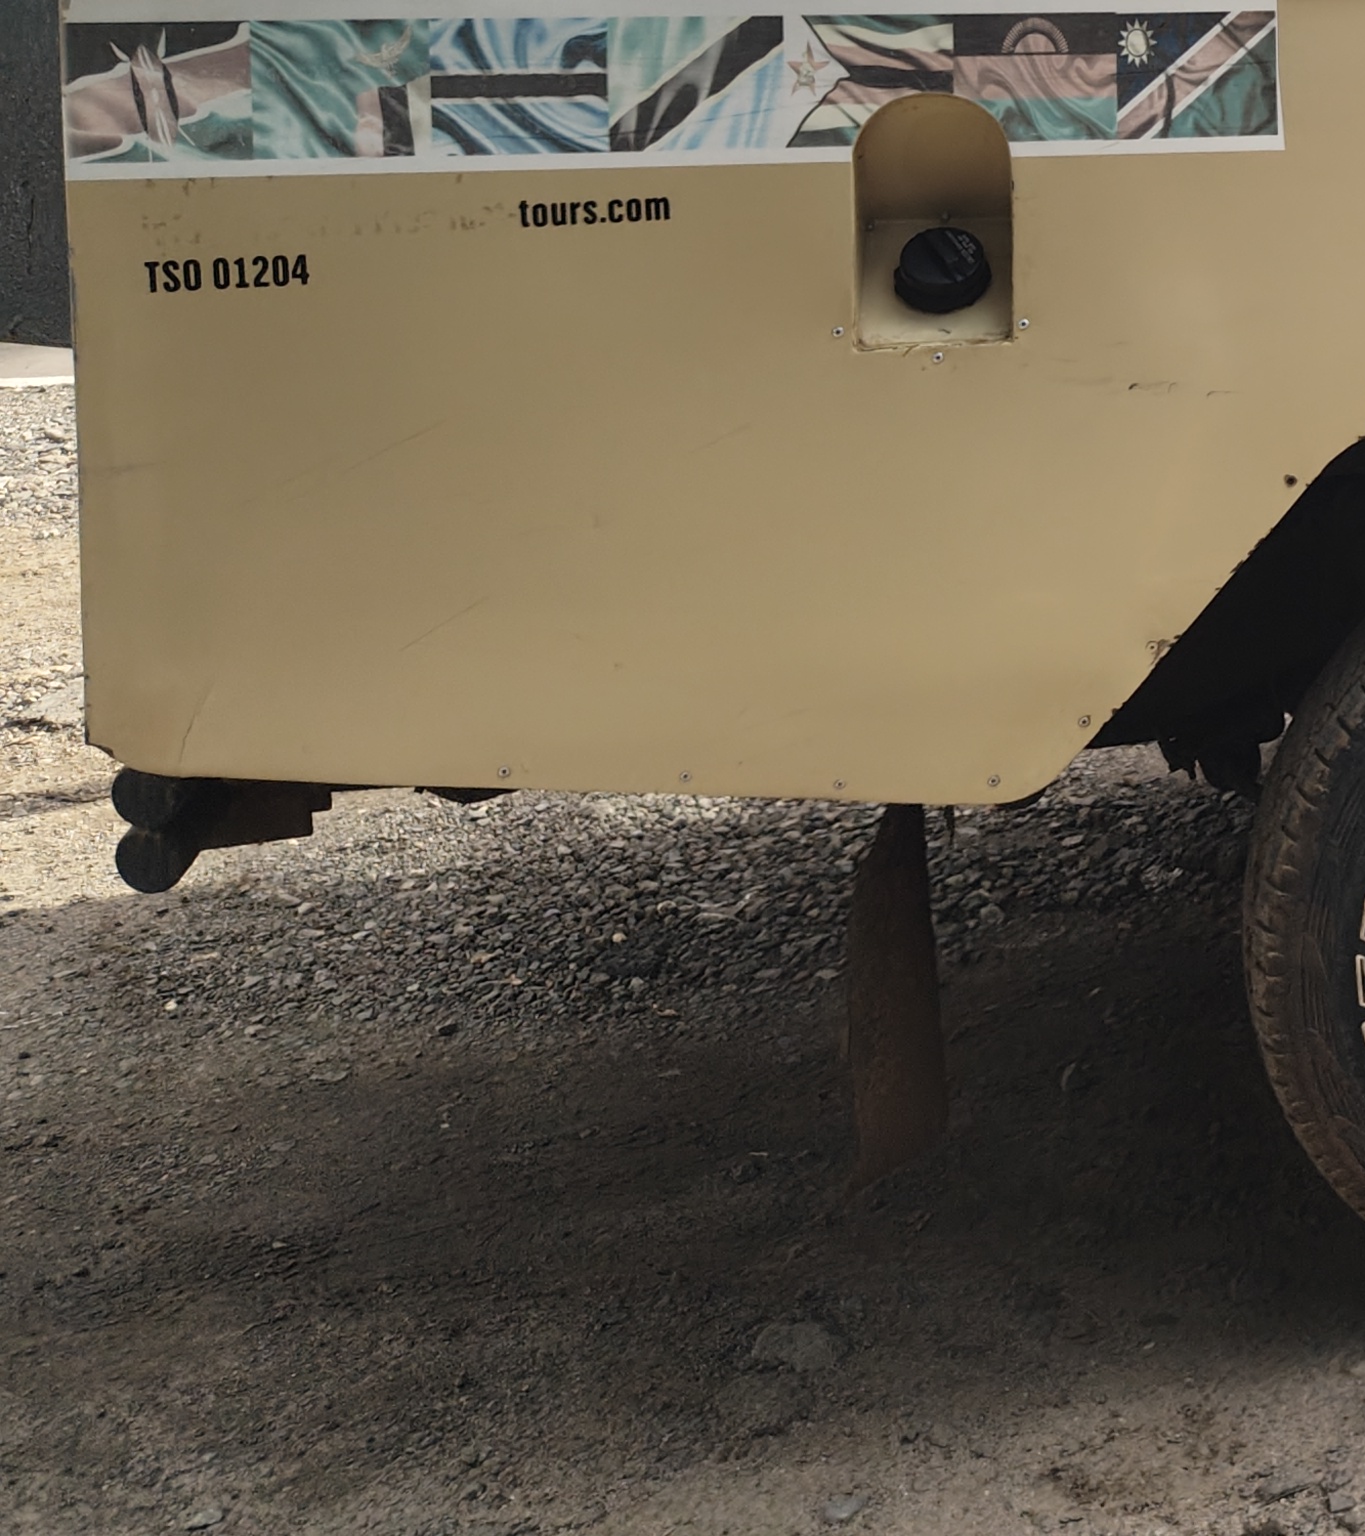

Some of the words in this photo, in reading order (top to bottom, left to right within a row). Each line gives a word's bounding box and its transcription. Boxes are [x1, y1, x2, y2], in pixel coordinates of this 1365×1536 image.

[518, 196, 671, 228] tours.com
[144, 261, 202, 293] TSO
[213, 255, 310, 290] 01204
